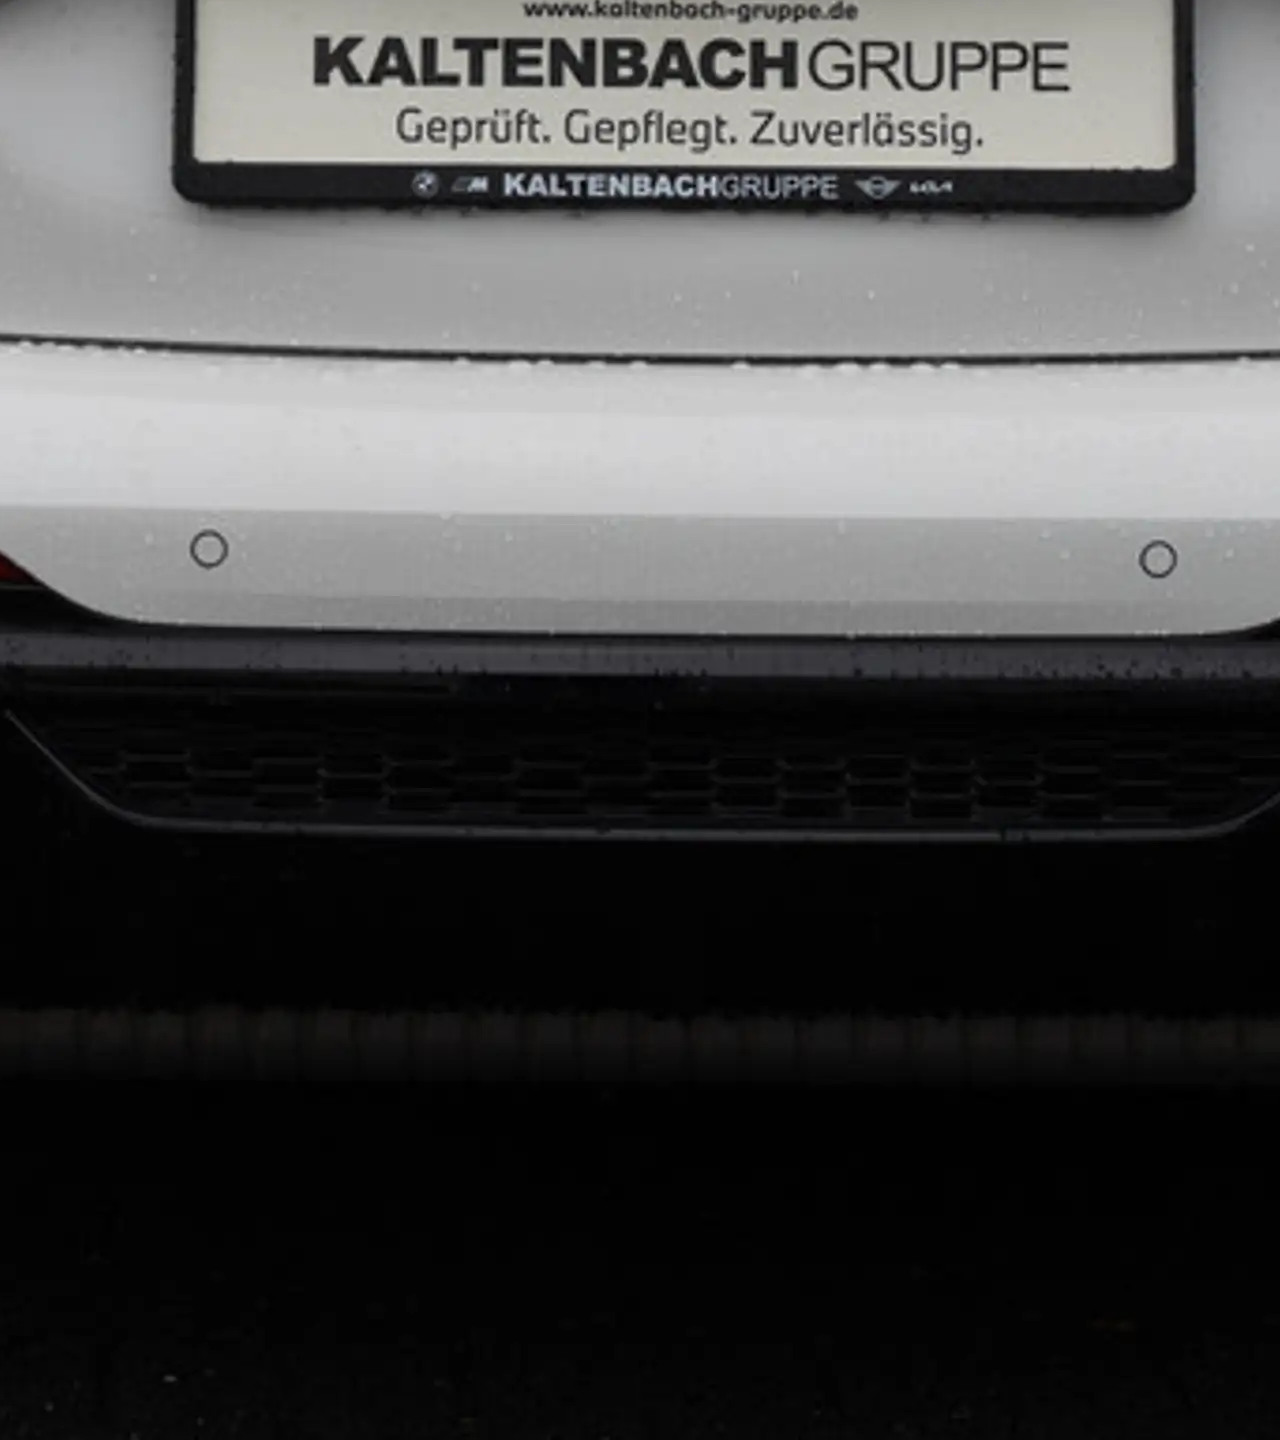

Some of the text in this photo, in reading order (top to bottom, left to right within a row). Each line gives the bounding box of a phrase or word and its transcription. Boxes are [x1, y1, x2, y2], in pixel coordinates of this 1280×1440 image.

[395, 107, 984, 155] Geprüft. Gepflegt. Zuverlässig.
